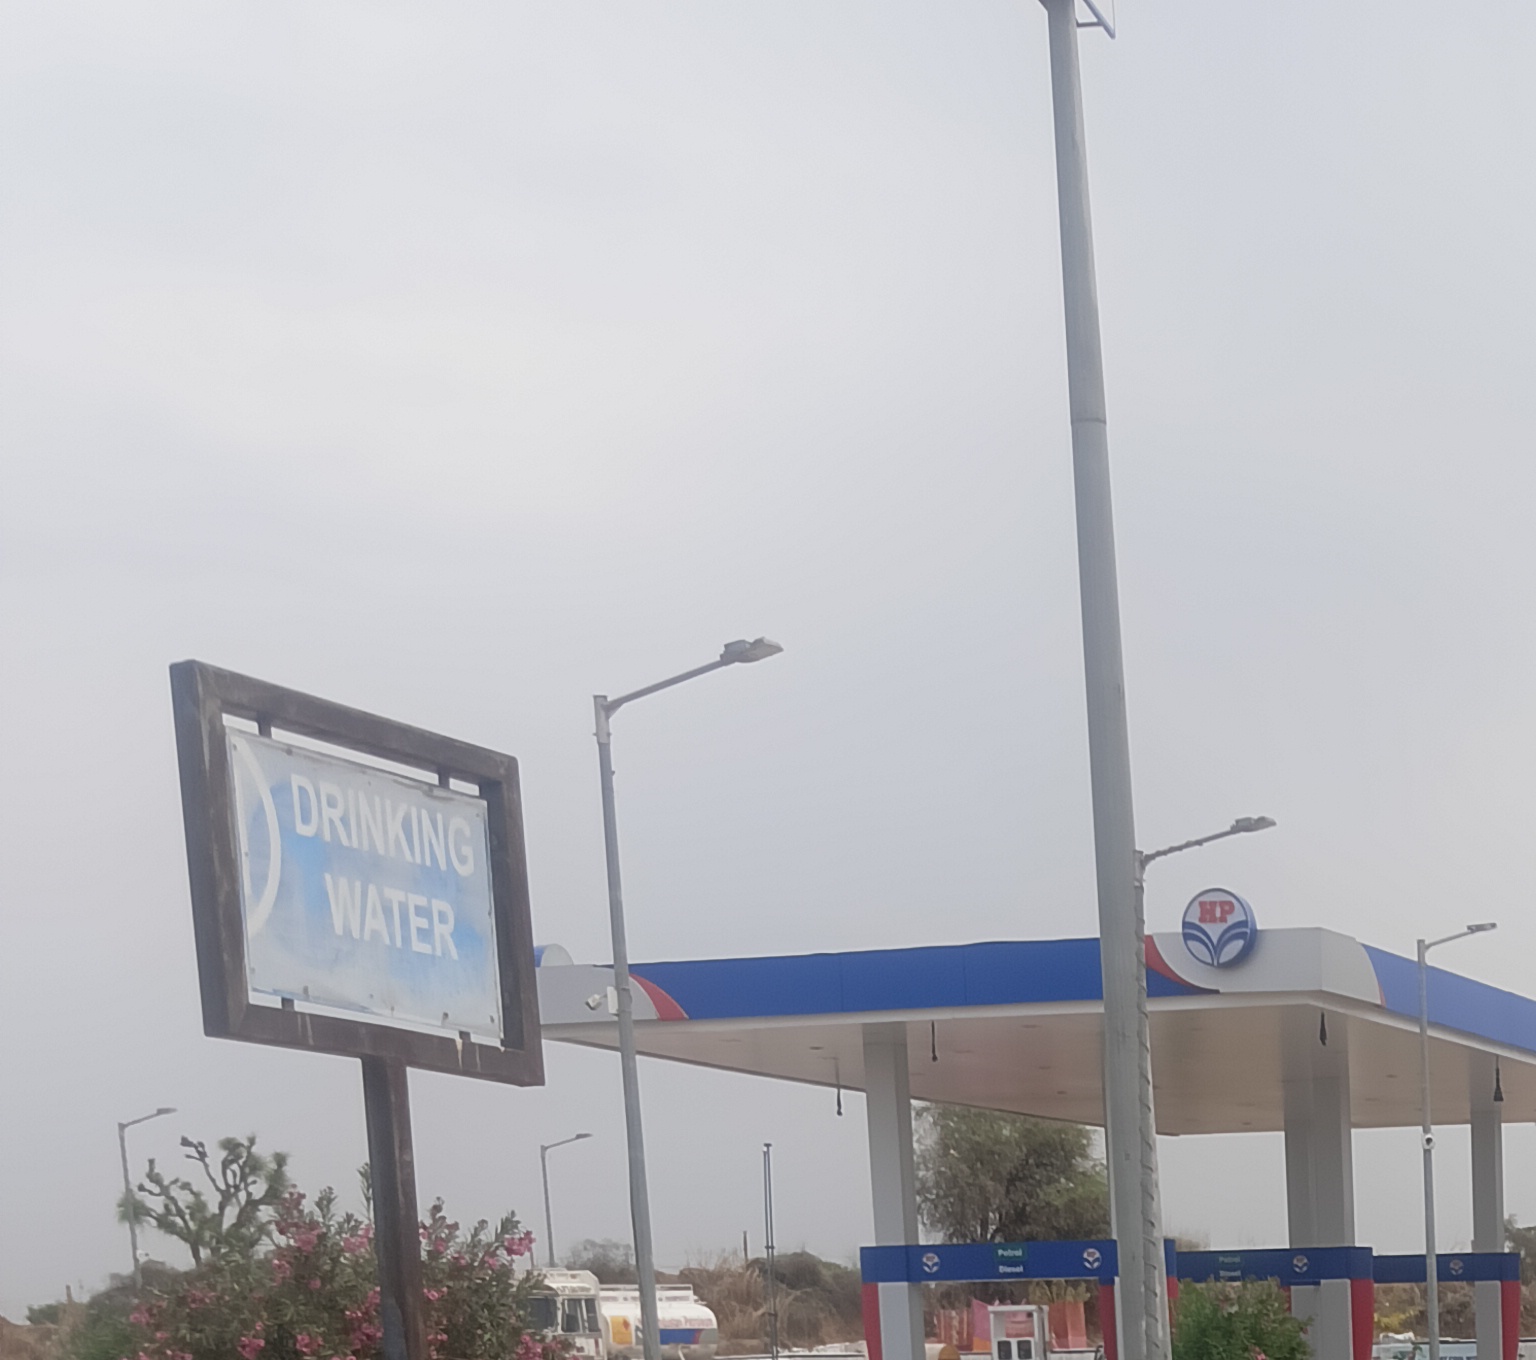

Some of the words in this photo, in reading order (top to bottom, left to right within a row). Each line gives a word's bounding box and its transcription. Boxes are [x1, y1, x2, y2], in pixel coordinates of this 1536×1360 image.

[290, 773, 475, 877] DRINKING
[324, 872, 459, 960] WATER
[1198, 900, 1235, 924] HP
[997, 1249, 1023, 1258] Petrol
[998, 1265, 1024, 1274] Diesel
